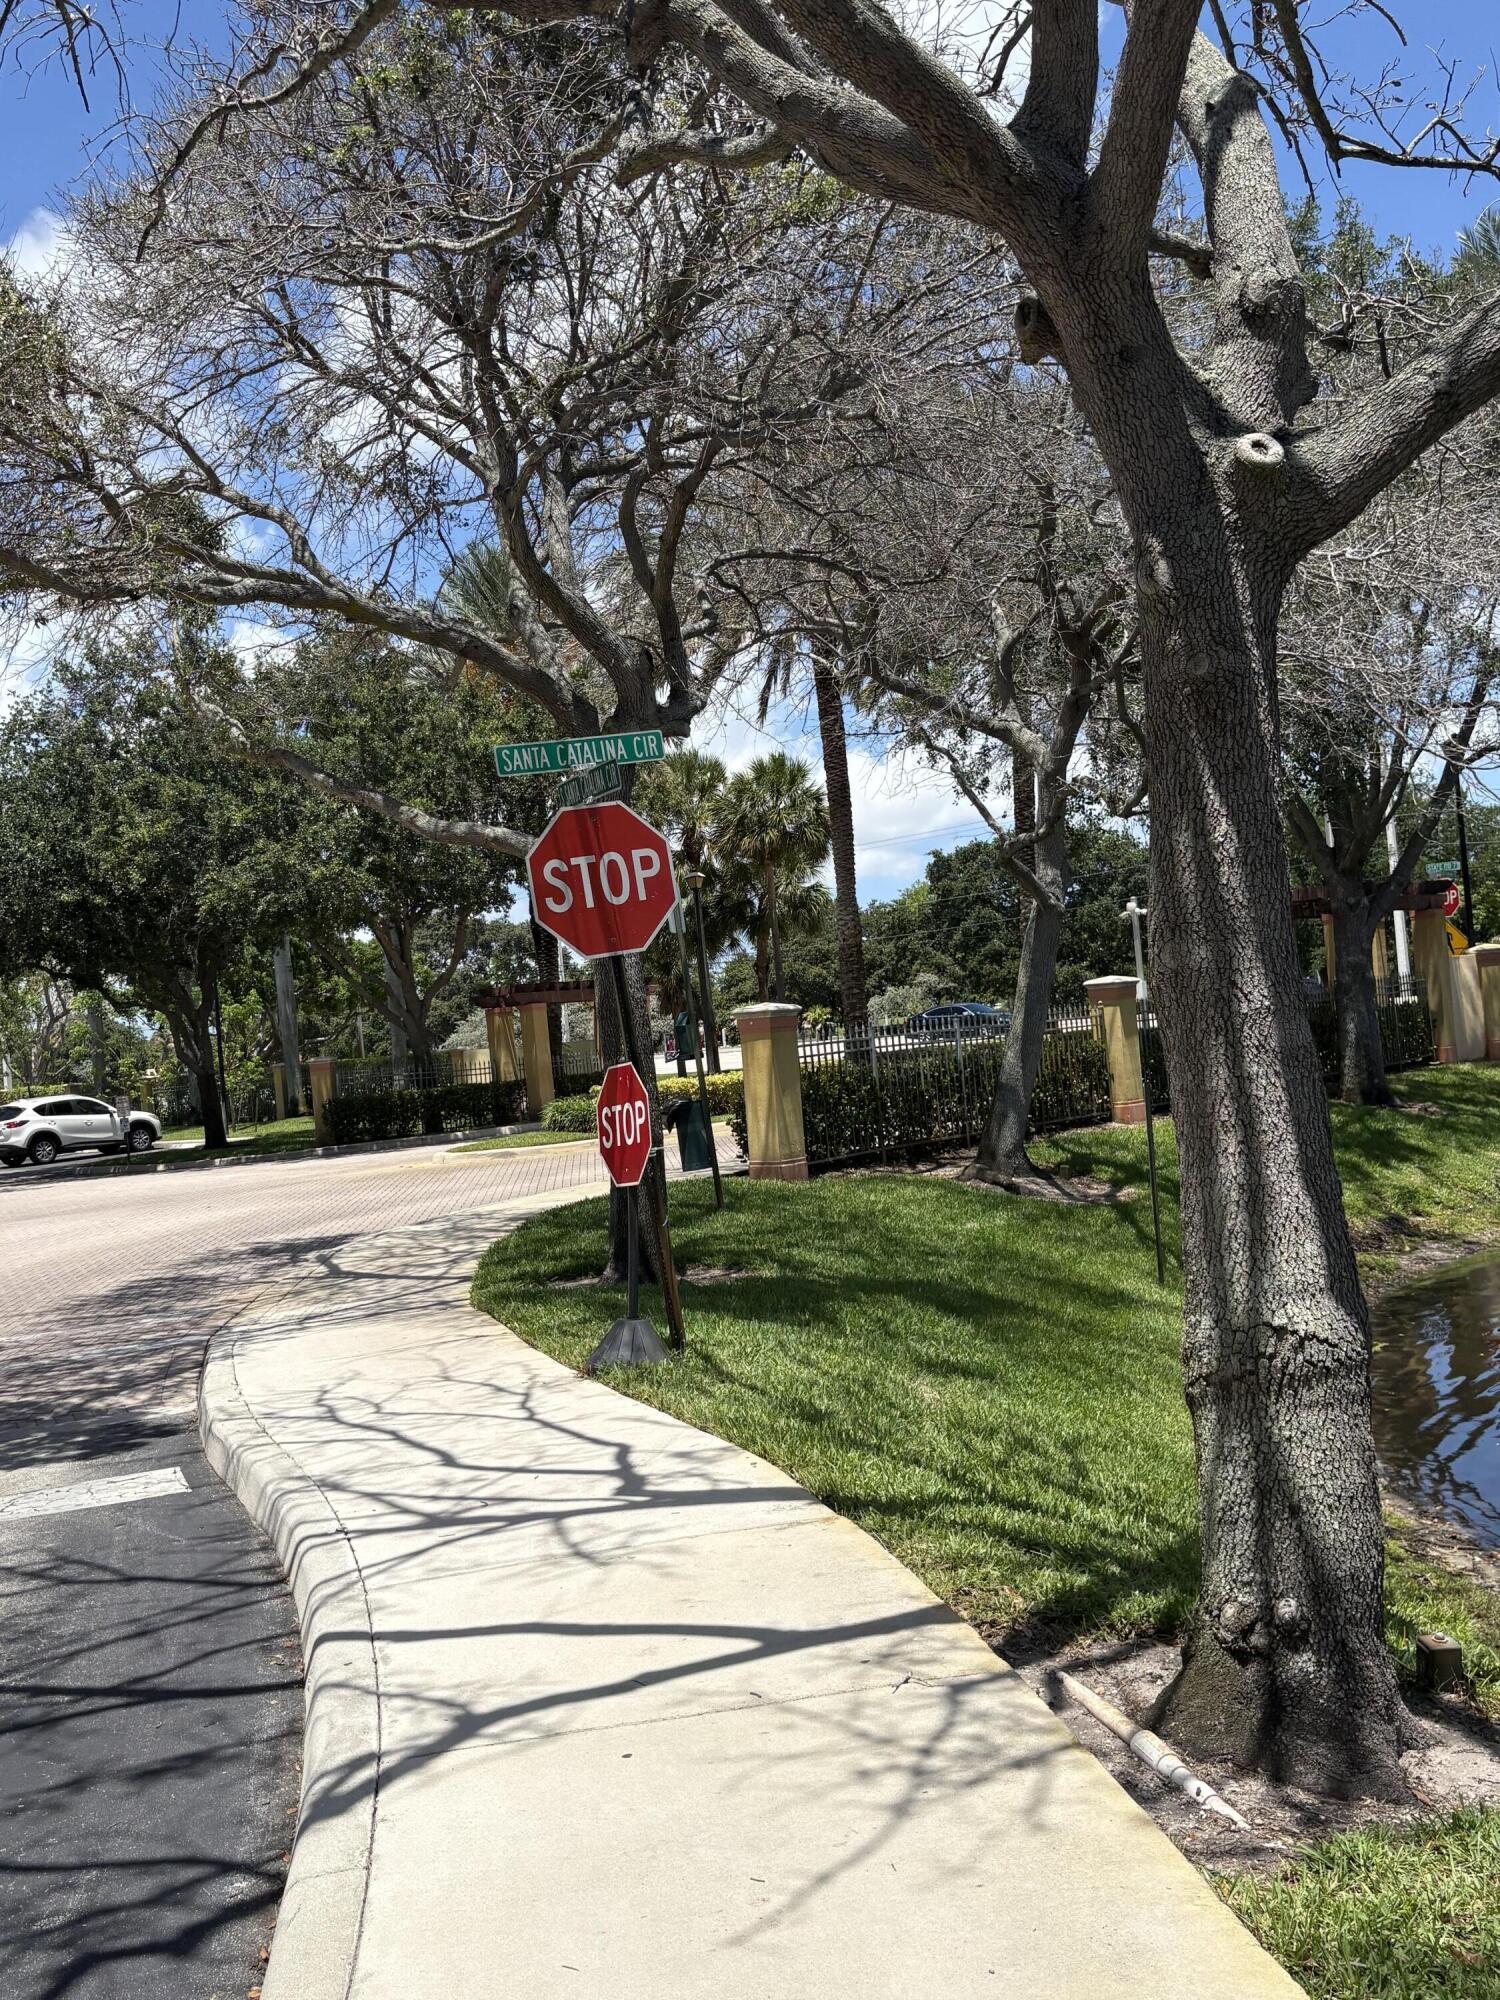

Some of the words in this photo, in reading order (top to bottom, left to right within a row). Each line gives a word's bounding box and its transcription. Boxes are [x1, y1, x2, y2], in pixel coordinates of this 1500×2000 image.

[501, 746, 551, 773] SANTA
[556, 738, 628, 767] CATALINA
[633, 735, 659, 758] CIR
[605, 763, 618, 789] CIR
[543, 848, 661, 913] STOP
[601, 1100, 646, 1149] STOP
